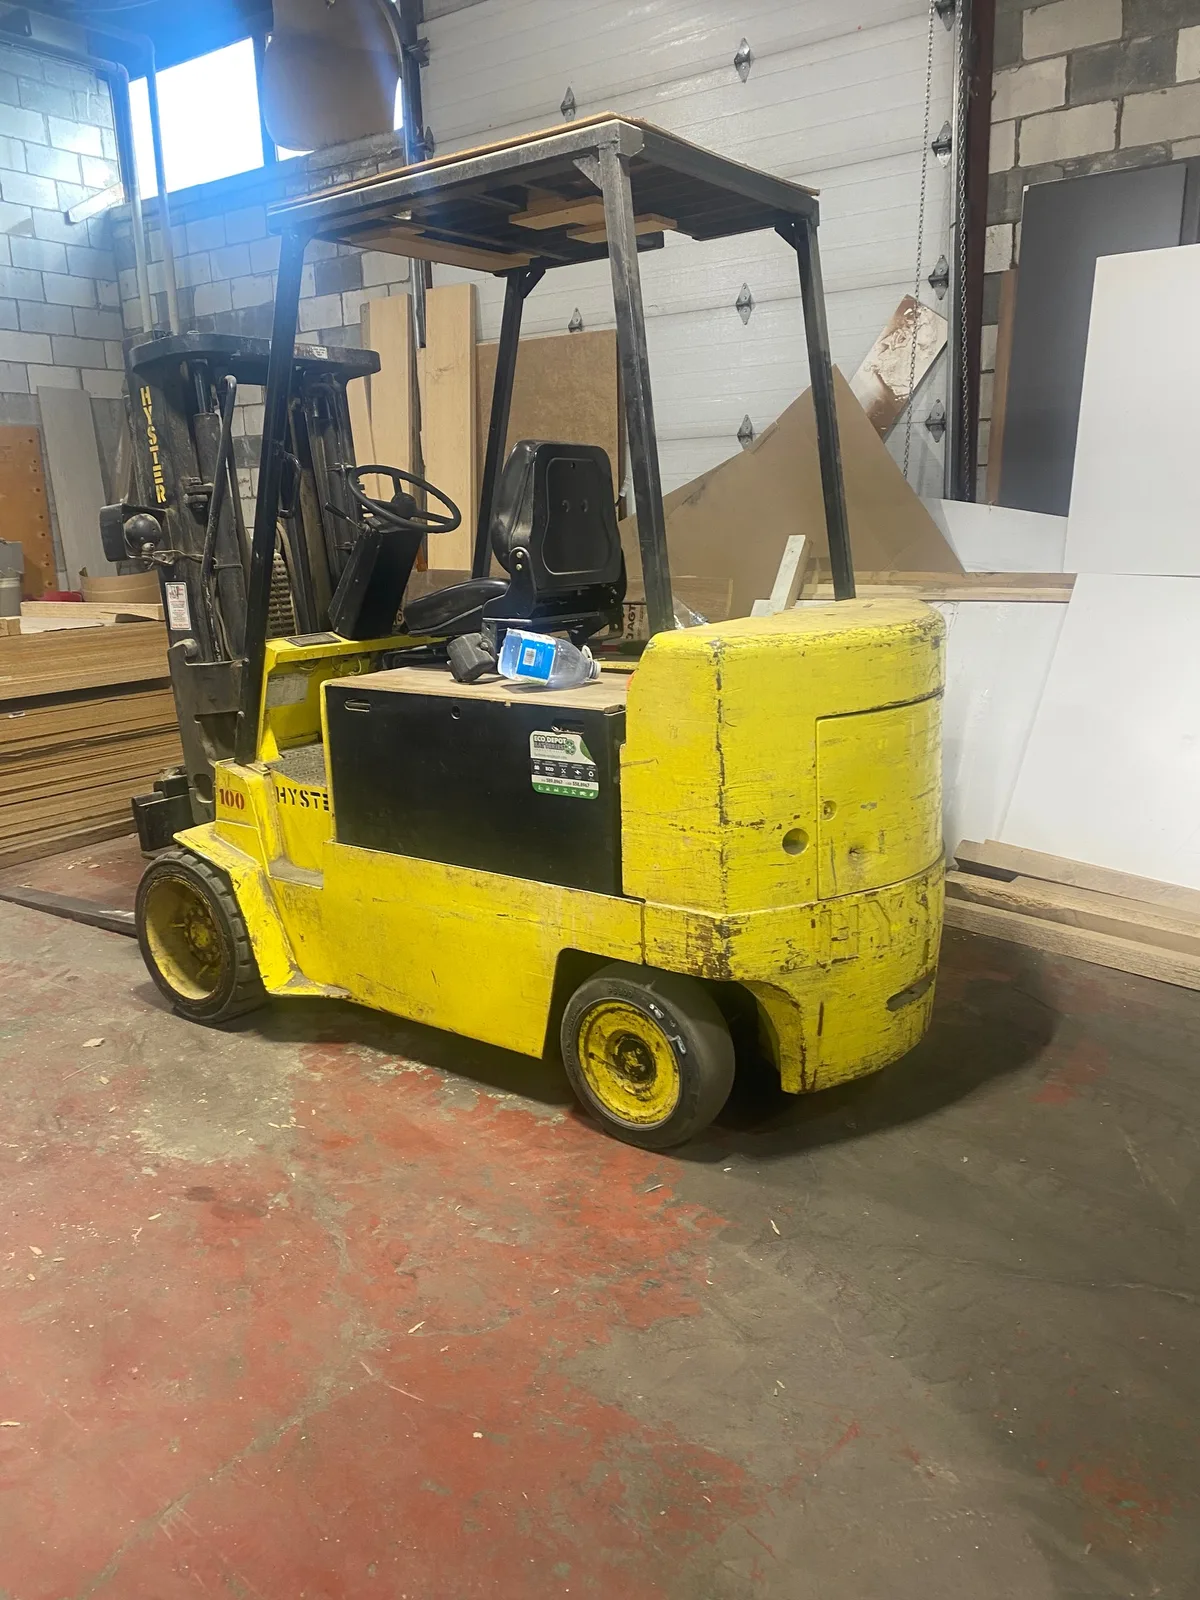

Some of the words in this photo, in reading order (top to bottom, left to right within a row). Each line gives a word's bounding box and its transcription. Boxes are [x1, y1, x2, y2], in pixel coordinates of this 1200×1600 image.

[139, 385, 167, 504] HYSTER
[546, 736, 567, 744] DEPOT
[219, 788, 245, 810] 100
